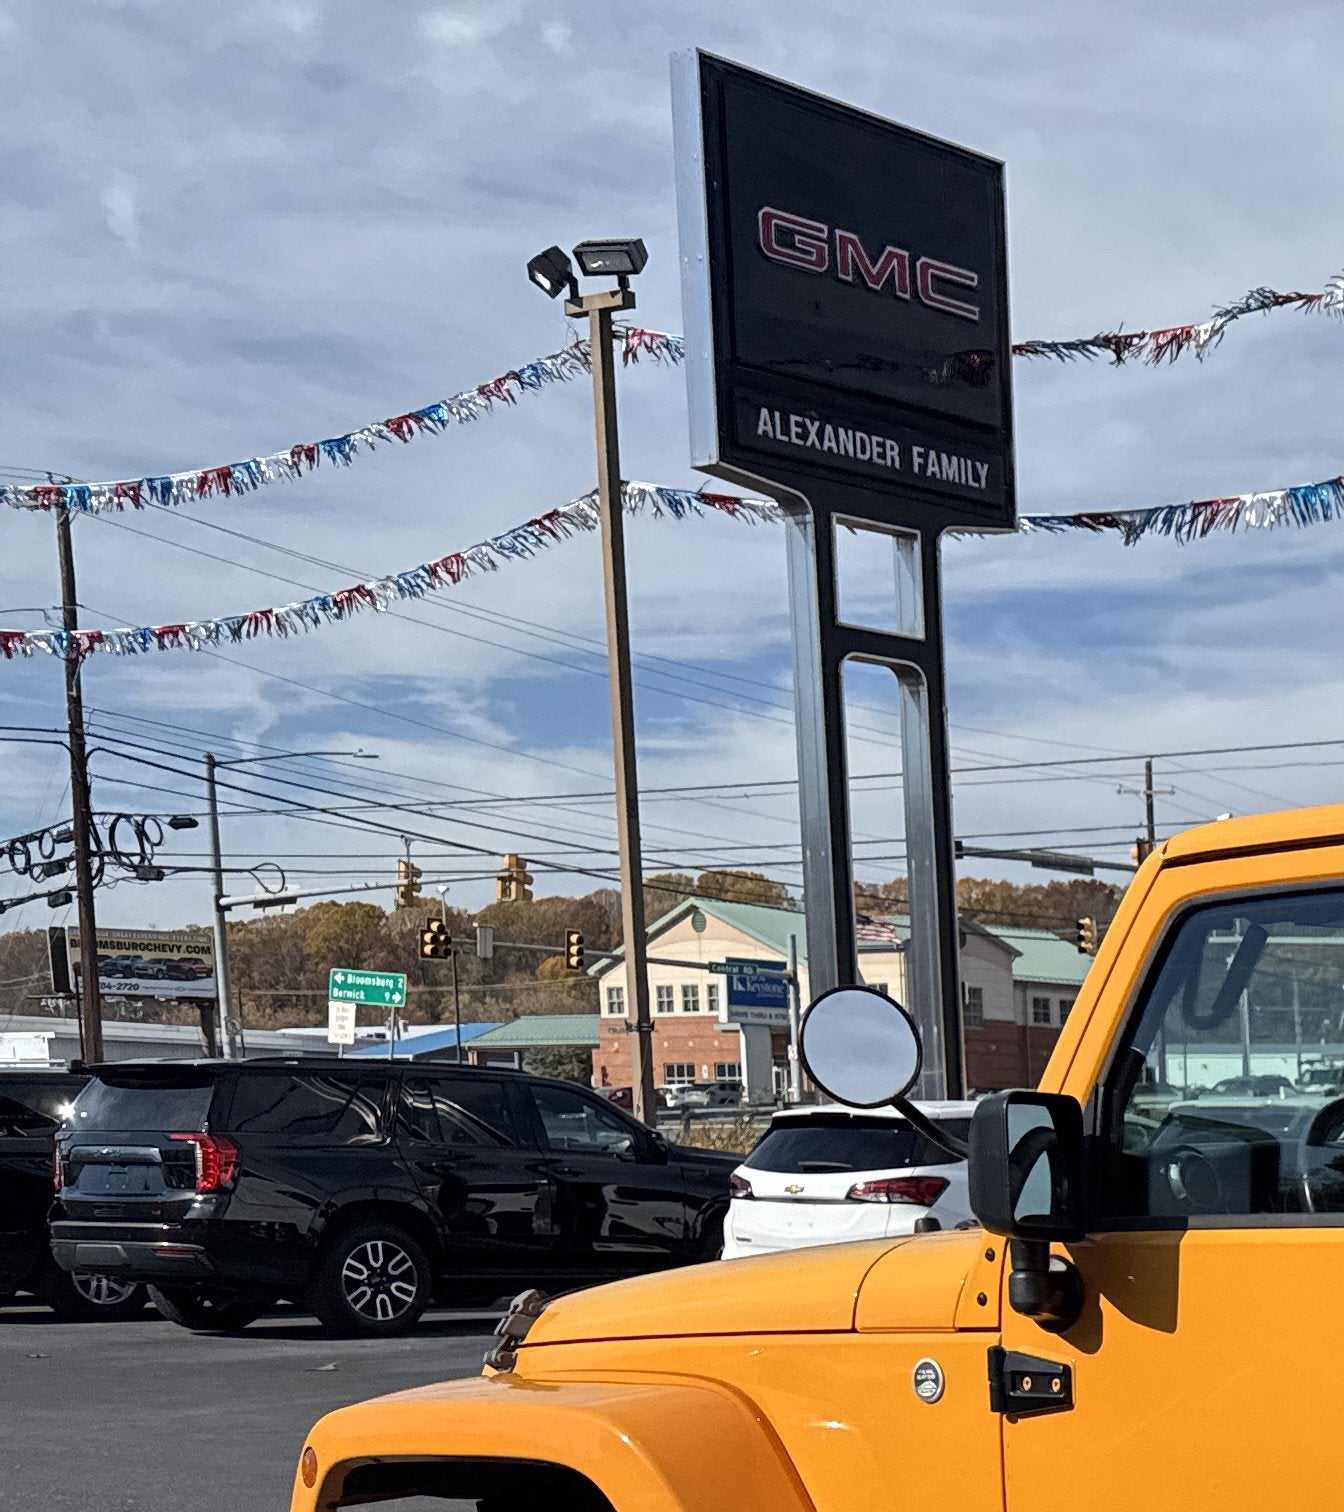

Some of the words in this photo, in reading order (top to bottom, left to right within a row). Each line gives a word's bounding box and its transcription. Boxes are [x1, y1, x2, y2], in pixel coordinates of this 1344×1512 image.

[758, 206, 980, 321] GMC
[757, 407, 900, 470] ALEXANDER
[912, 445, 989, 489] FAMILY
[70, 938, 212, 955] BMSBURGCHEVY.COM
[347, 974, 394, 989] Bloomsburg
[397, 977, 404, 989] 2
[333, 987, 366, 1000] Berwick
